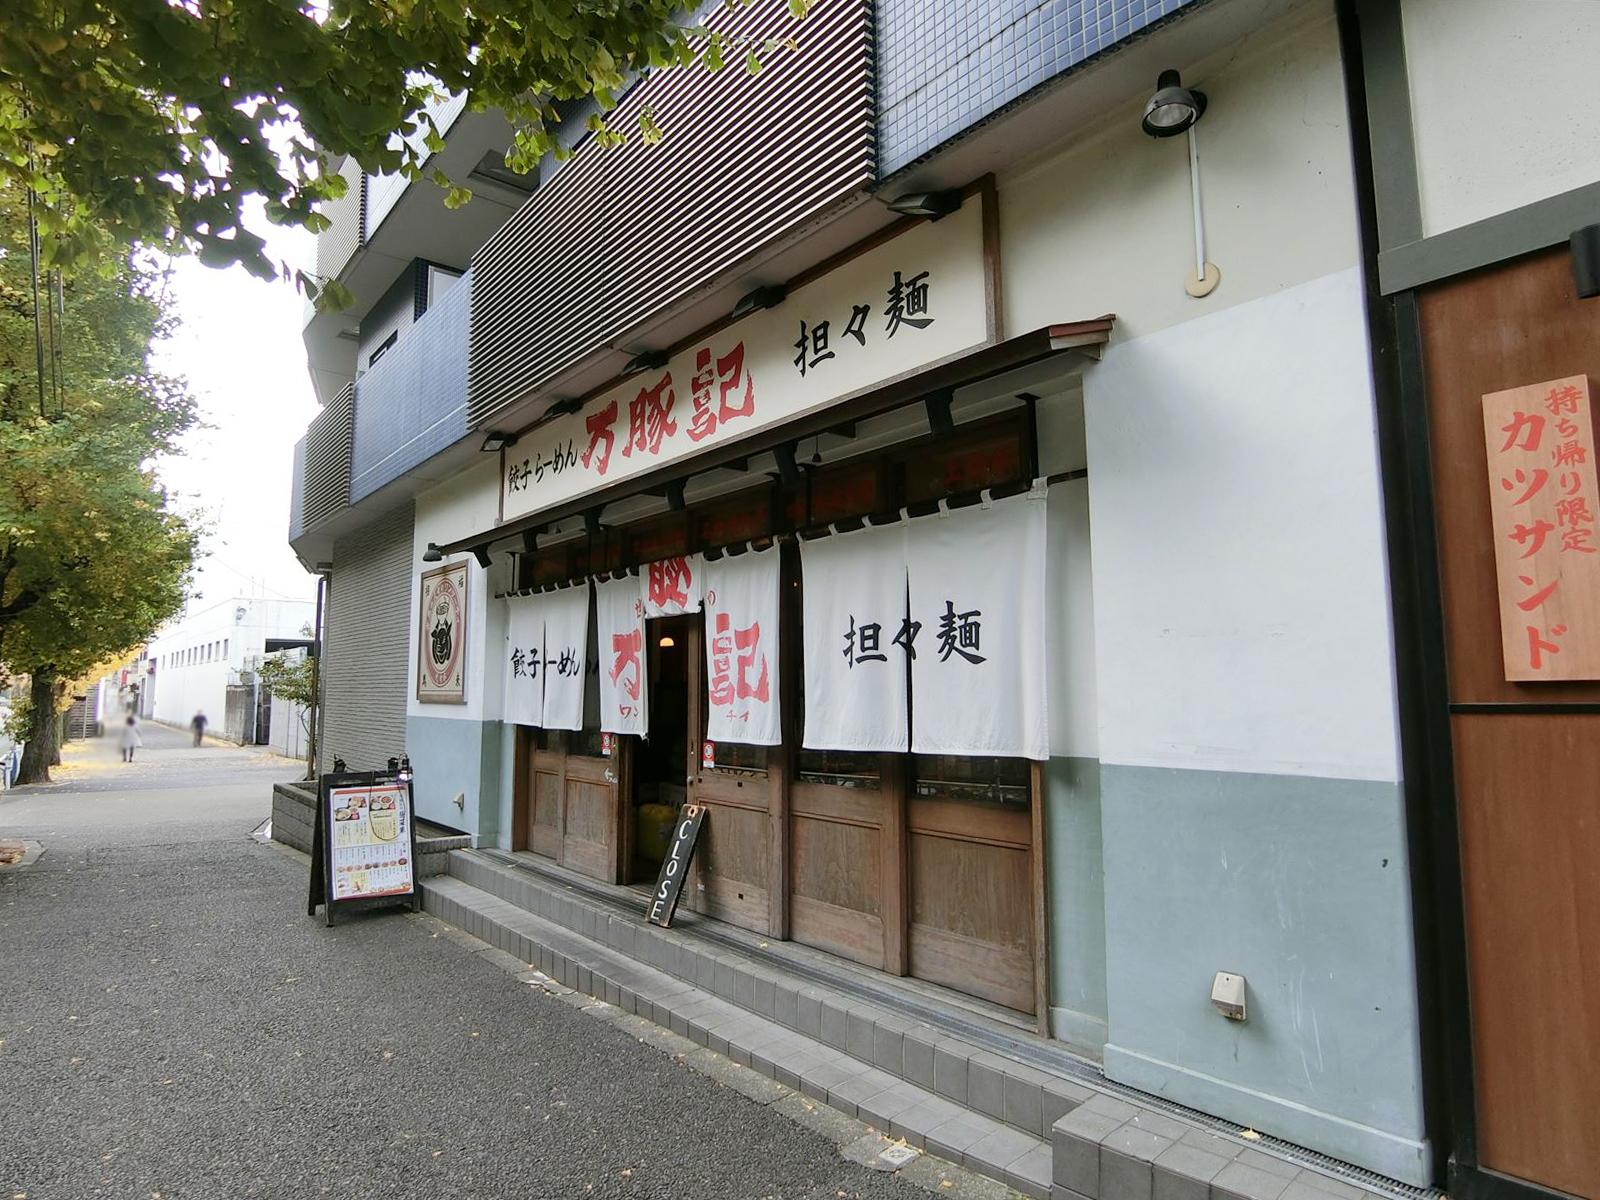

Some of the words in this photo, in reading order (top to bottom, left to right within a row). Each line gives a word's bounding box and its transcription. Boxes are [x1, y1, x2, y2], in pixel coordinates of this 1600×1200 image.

[507, 438, 578, 497] 餃子らーめん
[580, 340, 756, 476] 万豚記
[793, 271, 936, 378] 担々麺
[1545, 385, 1597, 554] 持ち帰り限定
[1500, 411, 1567, 670] カツサンド
[510, 646, 581, 680] 餃子ーめん
[842, 599, 988, 670] 担々麺
[650, 819, 692, 921] CLOSE
